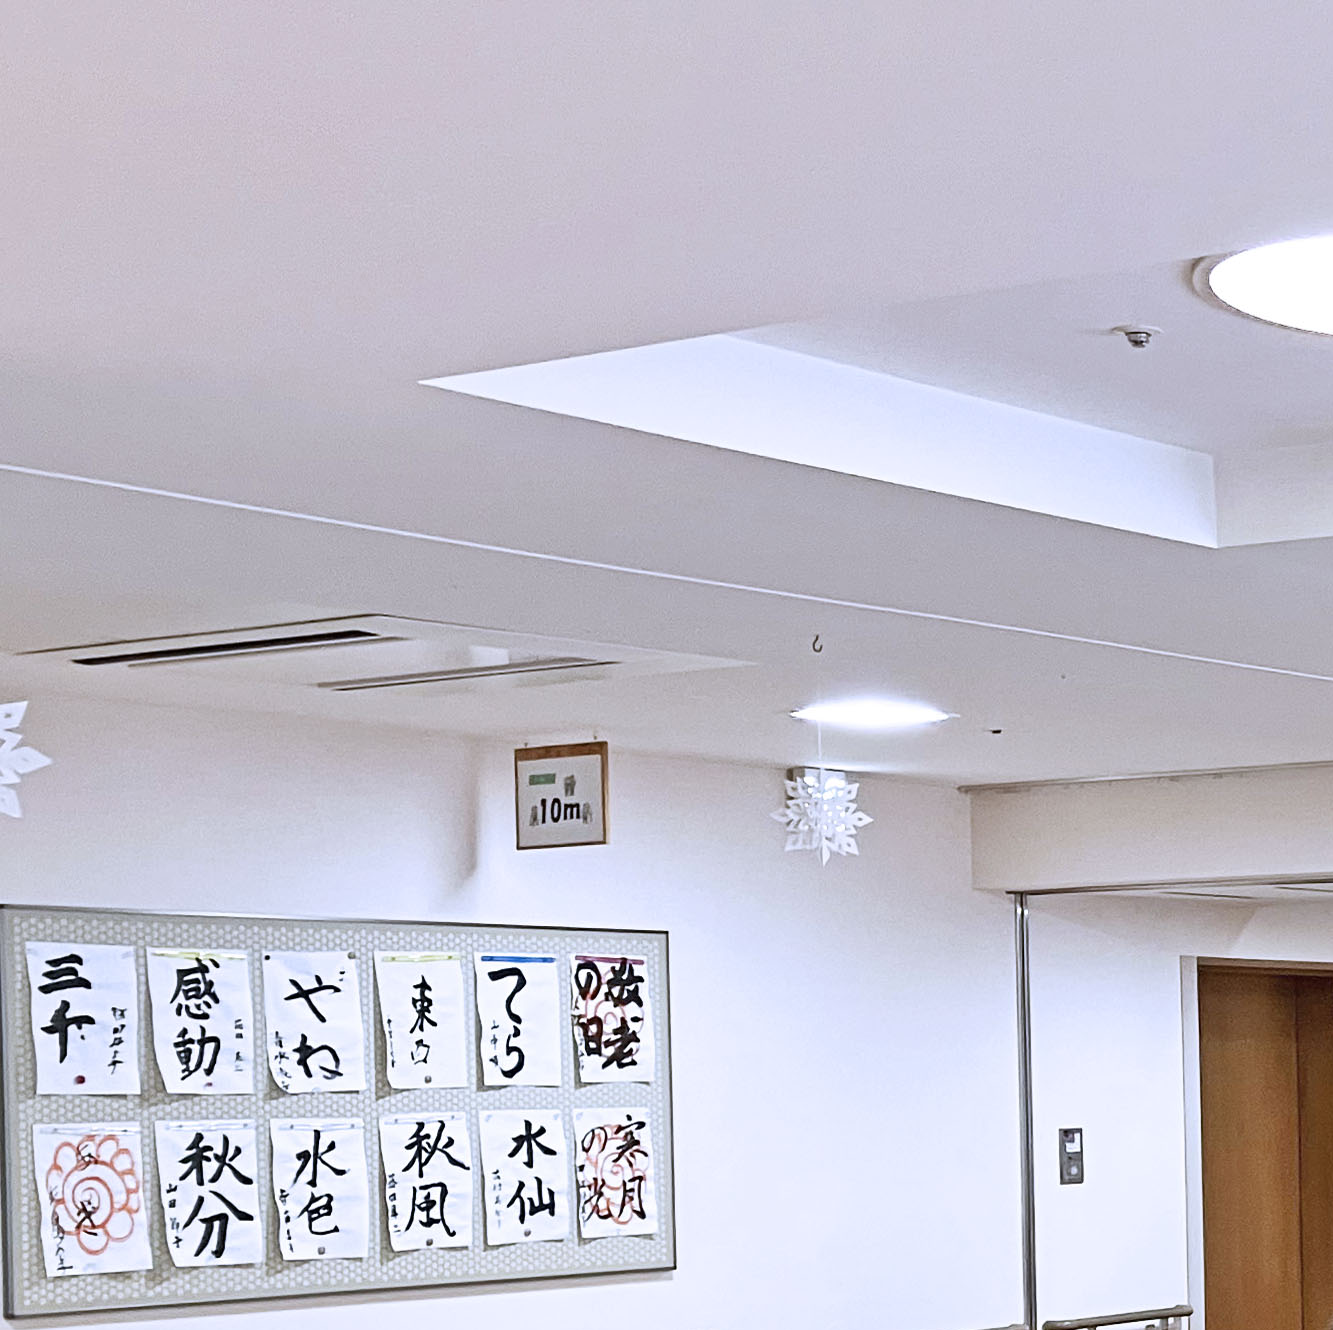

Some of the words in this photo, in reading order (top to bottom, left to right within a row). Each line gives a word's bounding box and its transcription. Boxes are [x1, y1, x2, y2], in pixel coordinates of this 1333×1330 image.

[540, 797, 580, 824] 10m
[170, 957, 221, 1081] 感動
[284, 973, 344, 1080] やね
[487, 967, 527, 1079] てら
[178, 1132, 254, 1259] 秋分
[292, 1129, 350, 1235] 水色
[402, 1120, 470, 1238] 秋風
[507, 1120, 557, 1225] 水仙
